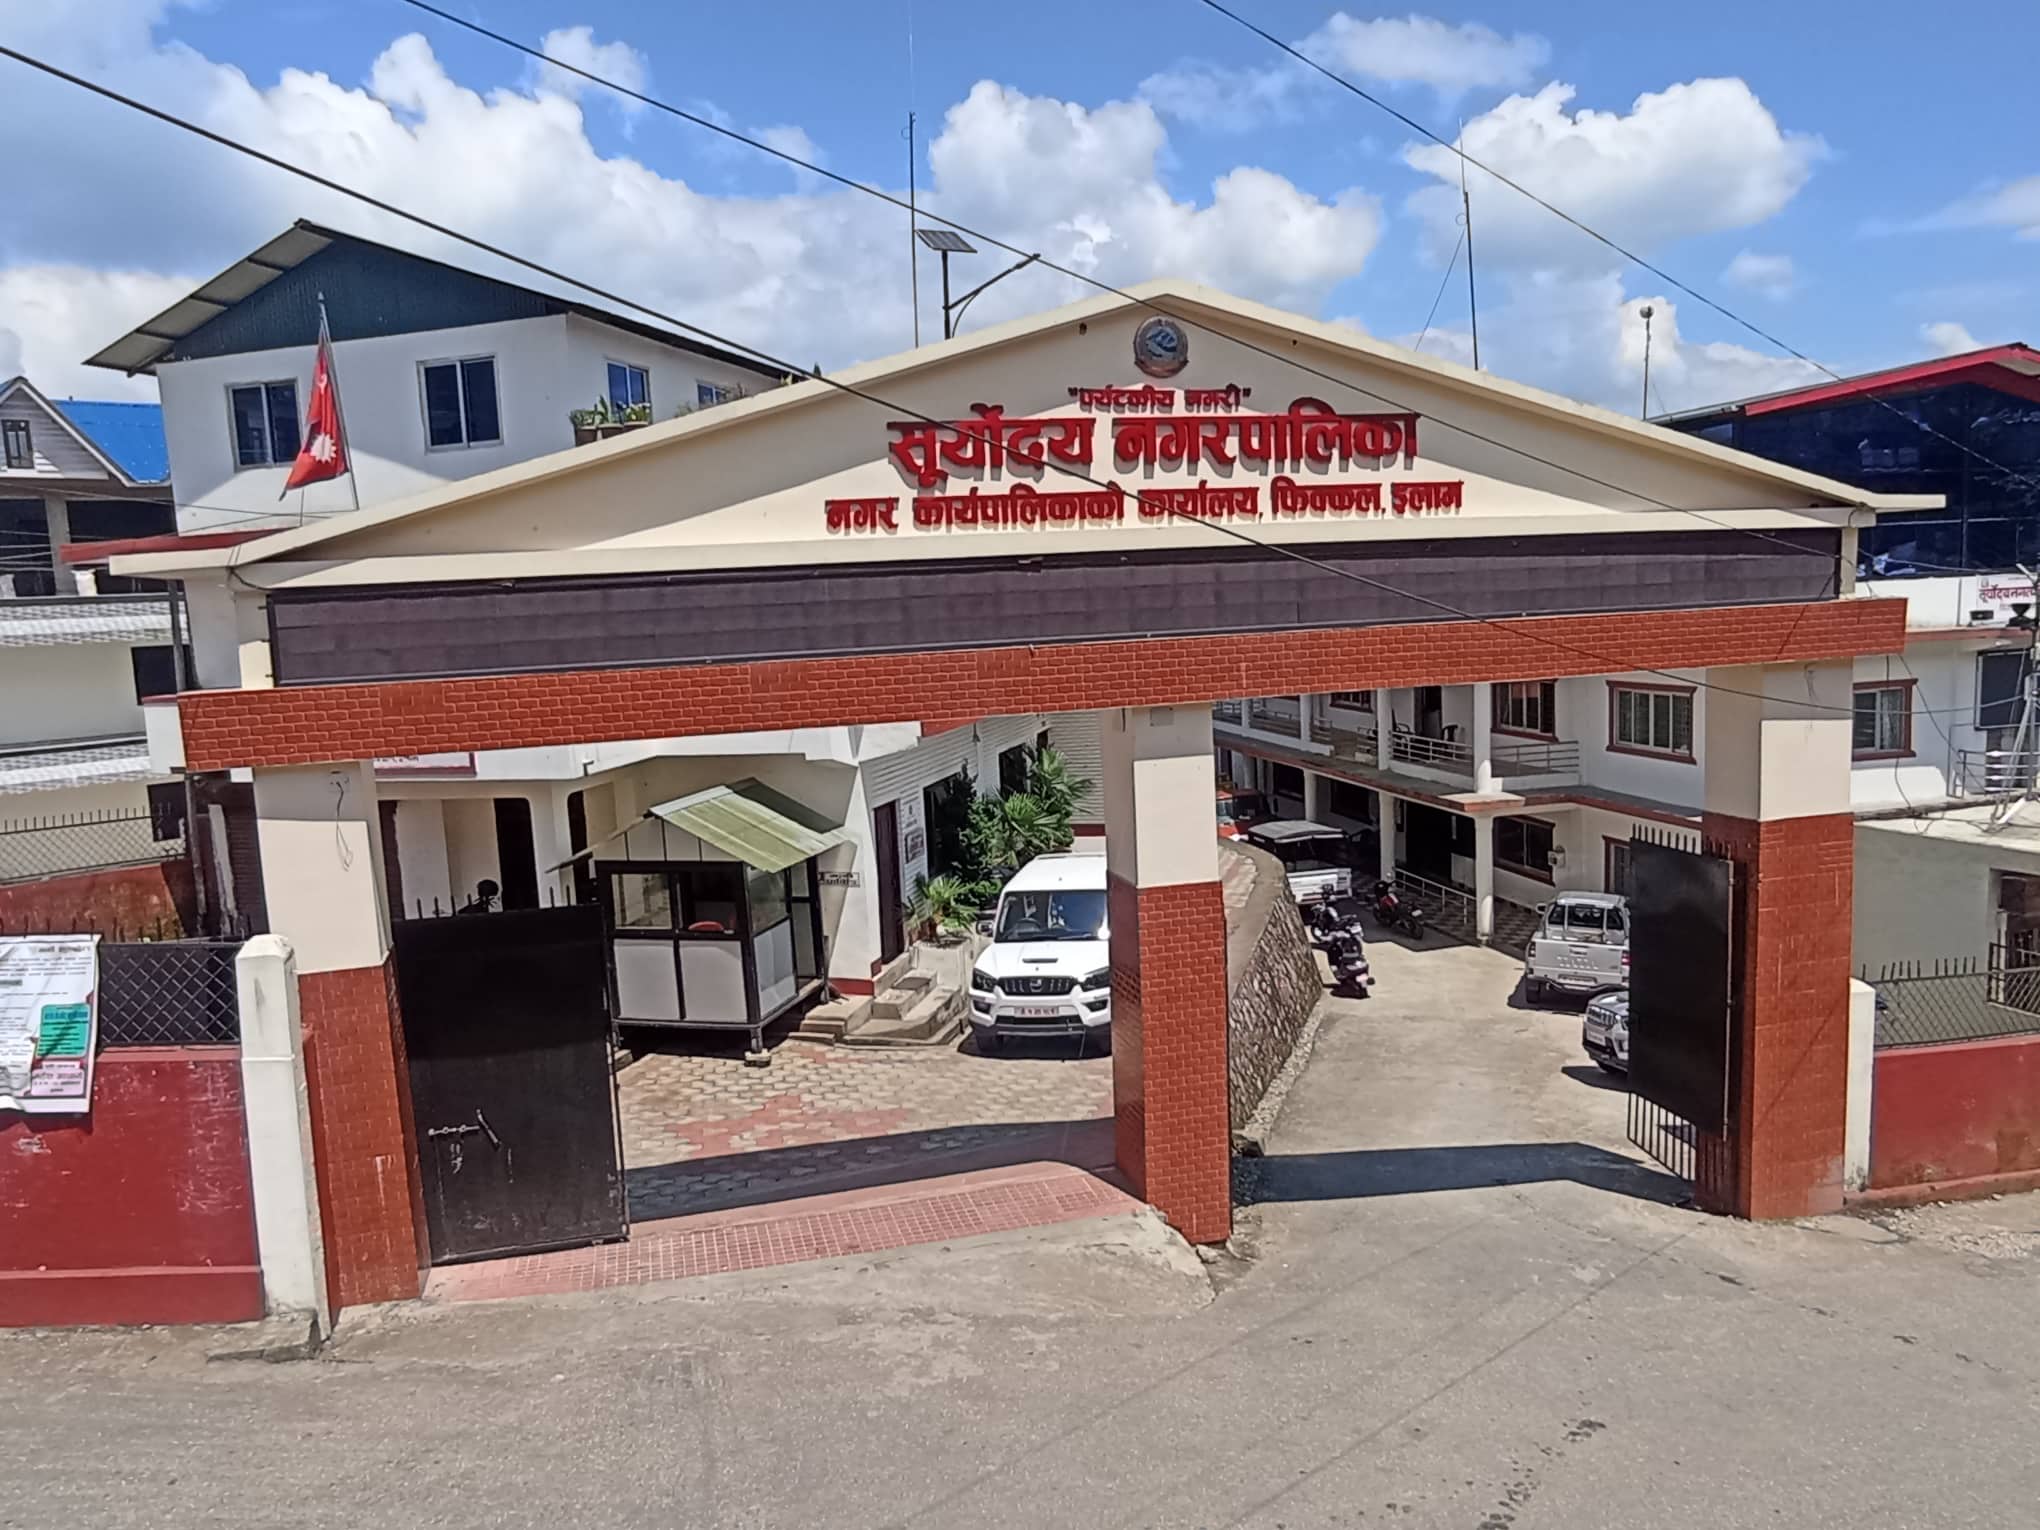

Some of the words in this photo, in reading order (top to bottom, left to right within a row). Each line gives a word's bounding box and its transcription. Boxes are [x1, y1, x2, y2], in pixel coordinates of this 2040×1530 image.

[887, 403, 1096, 487] सूर्योदय
[1112, 397, 1421, 465] नगरपालिका
[825, 497, 900, 530] नगर
[913, 480, 1125, 526] कार्यपालिकाको
[1138, 480, 1263, 524] कार्यालय,
[1391, 480, 1464, 514] इलाम
